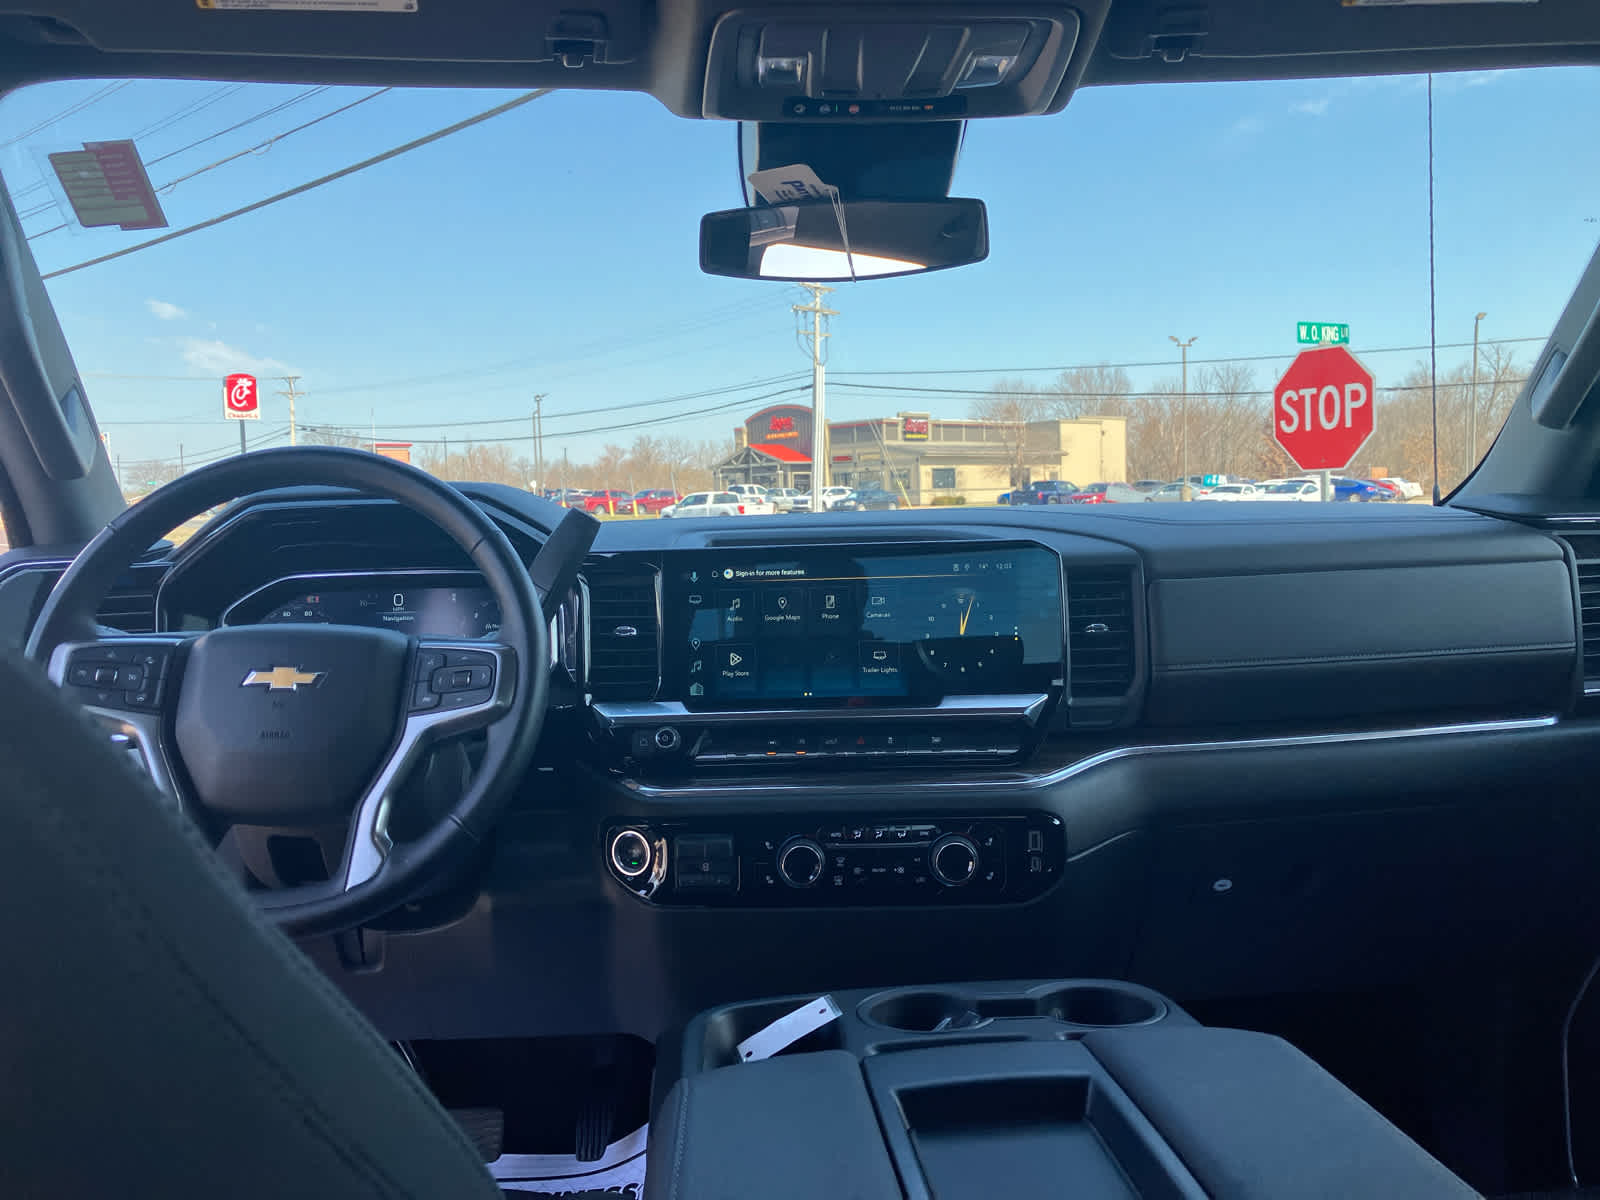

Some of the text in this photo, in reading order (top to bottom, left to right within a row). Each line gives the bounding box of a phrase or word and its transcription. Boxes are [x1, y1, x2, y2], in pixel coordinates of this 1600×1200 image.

[1299, 325, 1309, 340] W.
[1311, 325, 1320, 340] O.
[1321, 326, 1339, 341] KING
[1280, 382, 1367, 433] STOP
[781, 568, 805, 576] features
[393, 593, 404, 606] 0
[765, 614, 784, 622] Google
[881, 666, 898, 674] Lights
